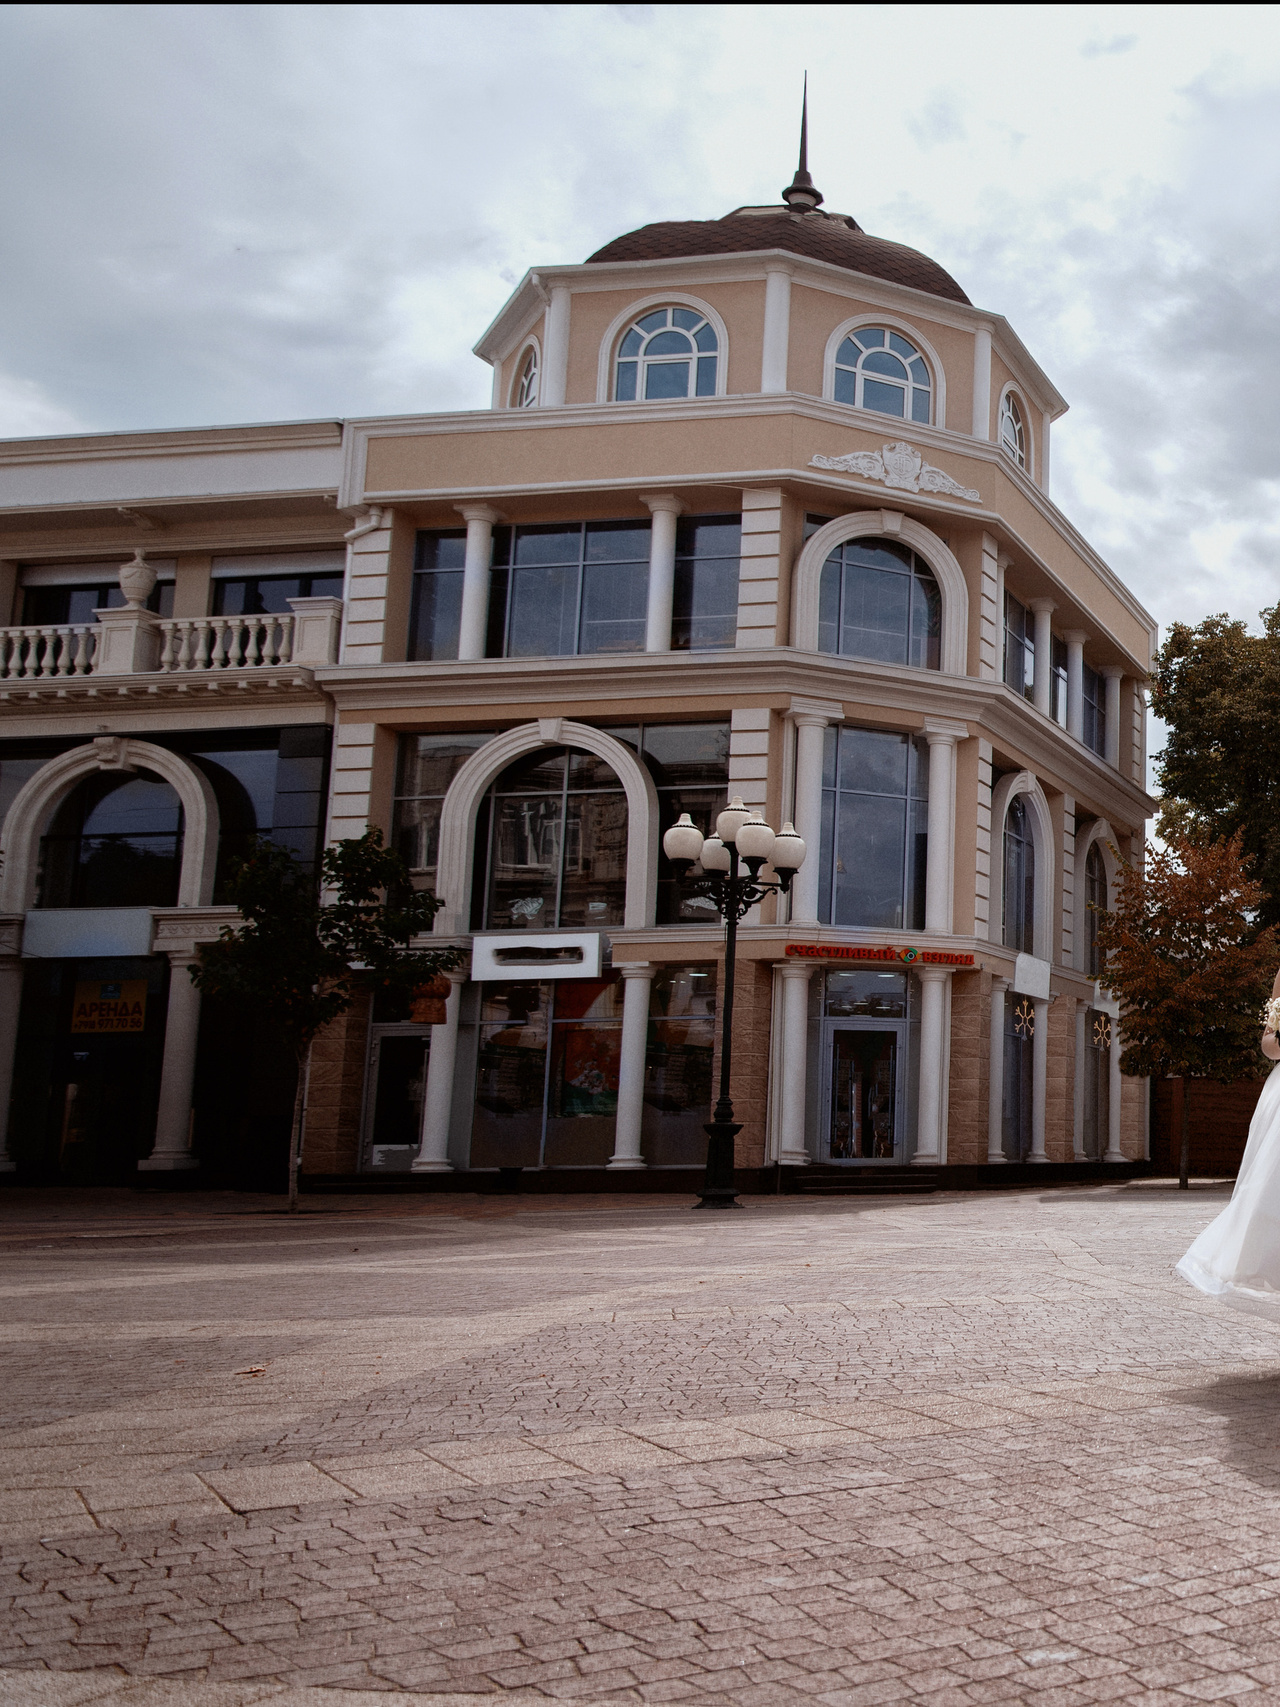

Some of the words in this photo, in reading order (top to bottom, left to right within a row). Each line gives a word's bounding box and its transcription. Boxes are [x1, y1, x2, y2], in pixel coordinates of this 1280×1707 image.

[785, 944, 896, 960] счастливый
[923, 951, 975, 965] взгляд
[76, 1001, 142, 1017] АРЕНДА
[98, 1018, 113, 1028] 971
[115, 1018, 128, 1028] 70
[129, 1018, 142, 1028] 56
